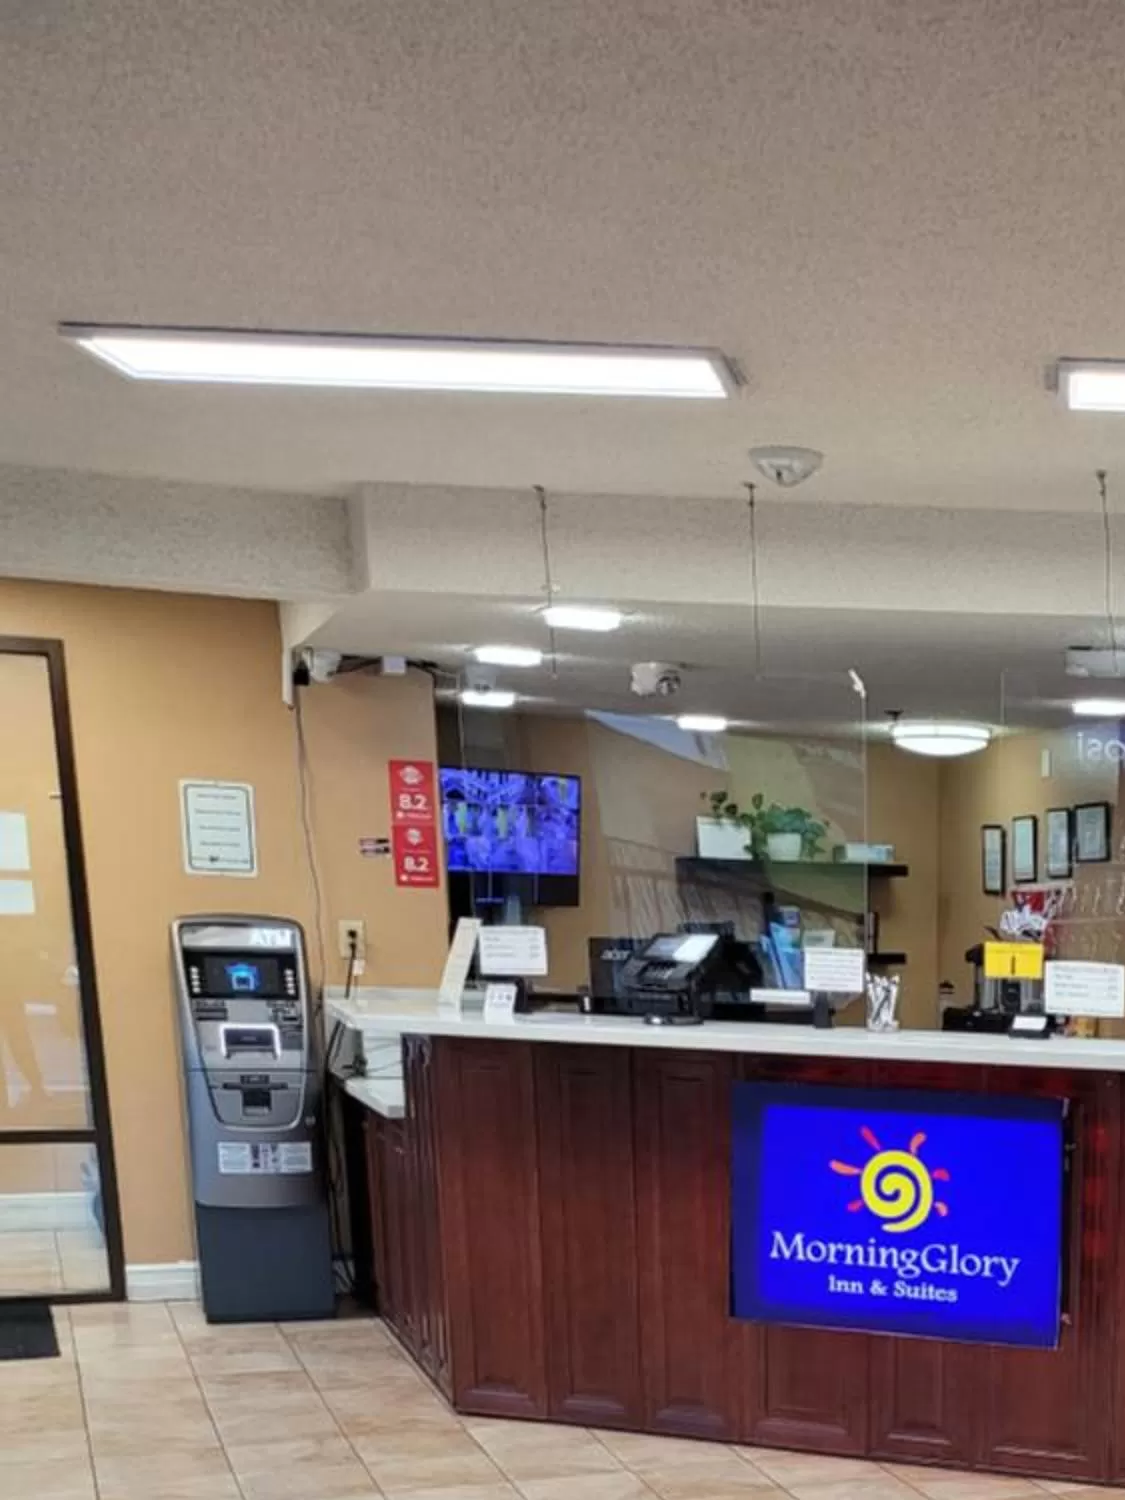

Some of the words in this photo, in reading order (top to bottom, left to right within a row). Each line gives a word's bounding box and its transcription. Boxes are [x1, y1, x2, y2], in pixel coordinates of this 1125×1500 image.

[399, 793, 429, 811] 8.2
[403, 856, 430, 873] 8.2
[250, 928, 291, 947] ATM
[769, 1230, 1020, 1287] MorningGlory
[828, 1274, 864, 1295] Inn
[869, 1279, 888, 1297] &
[893, 1280, 958, 1303] Suites
